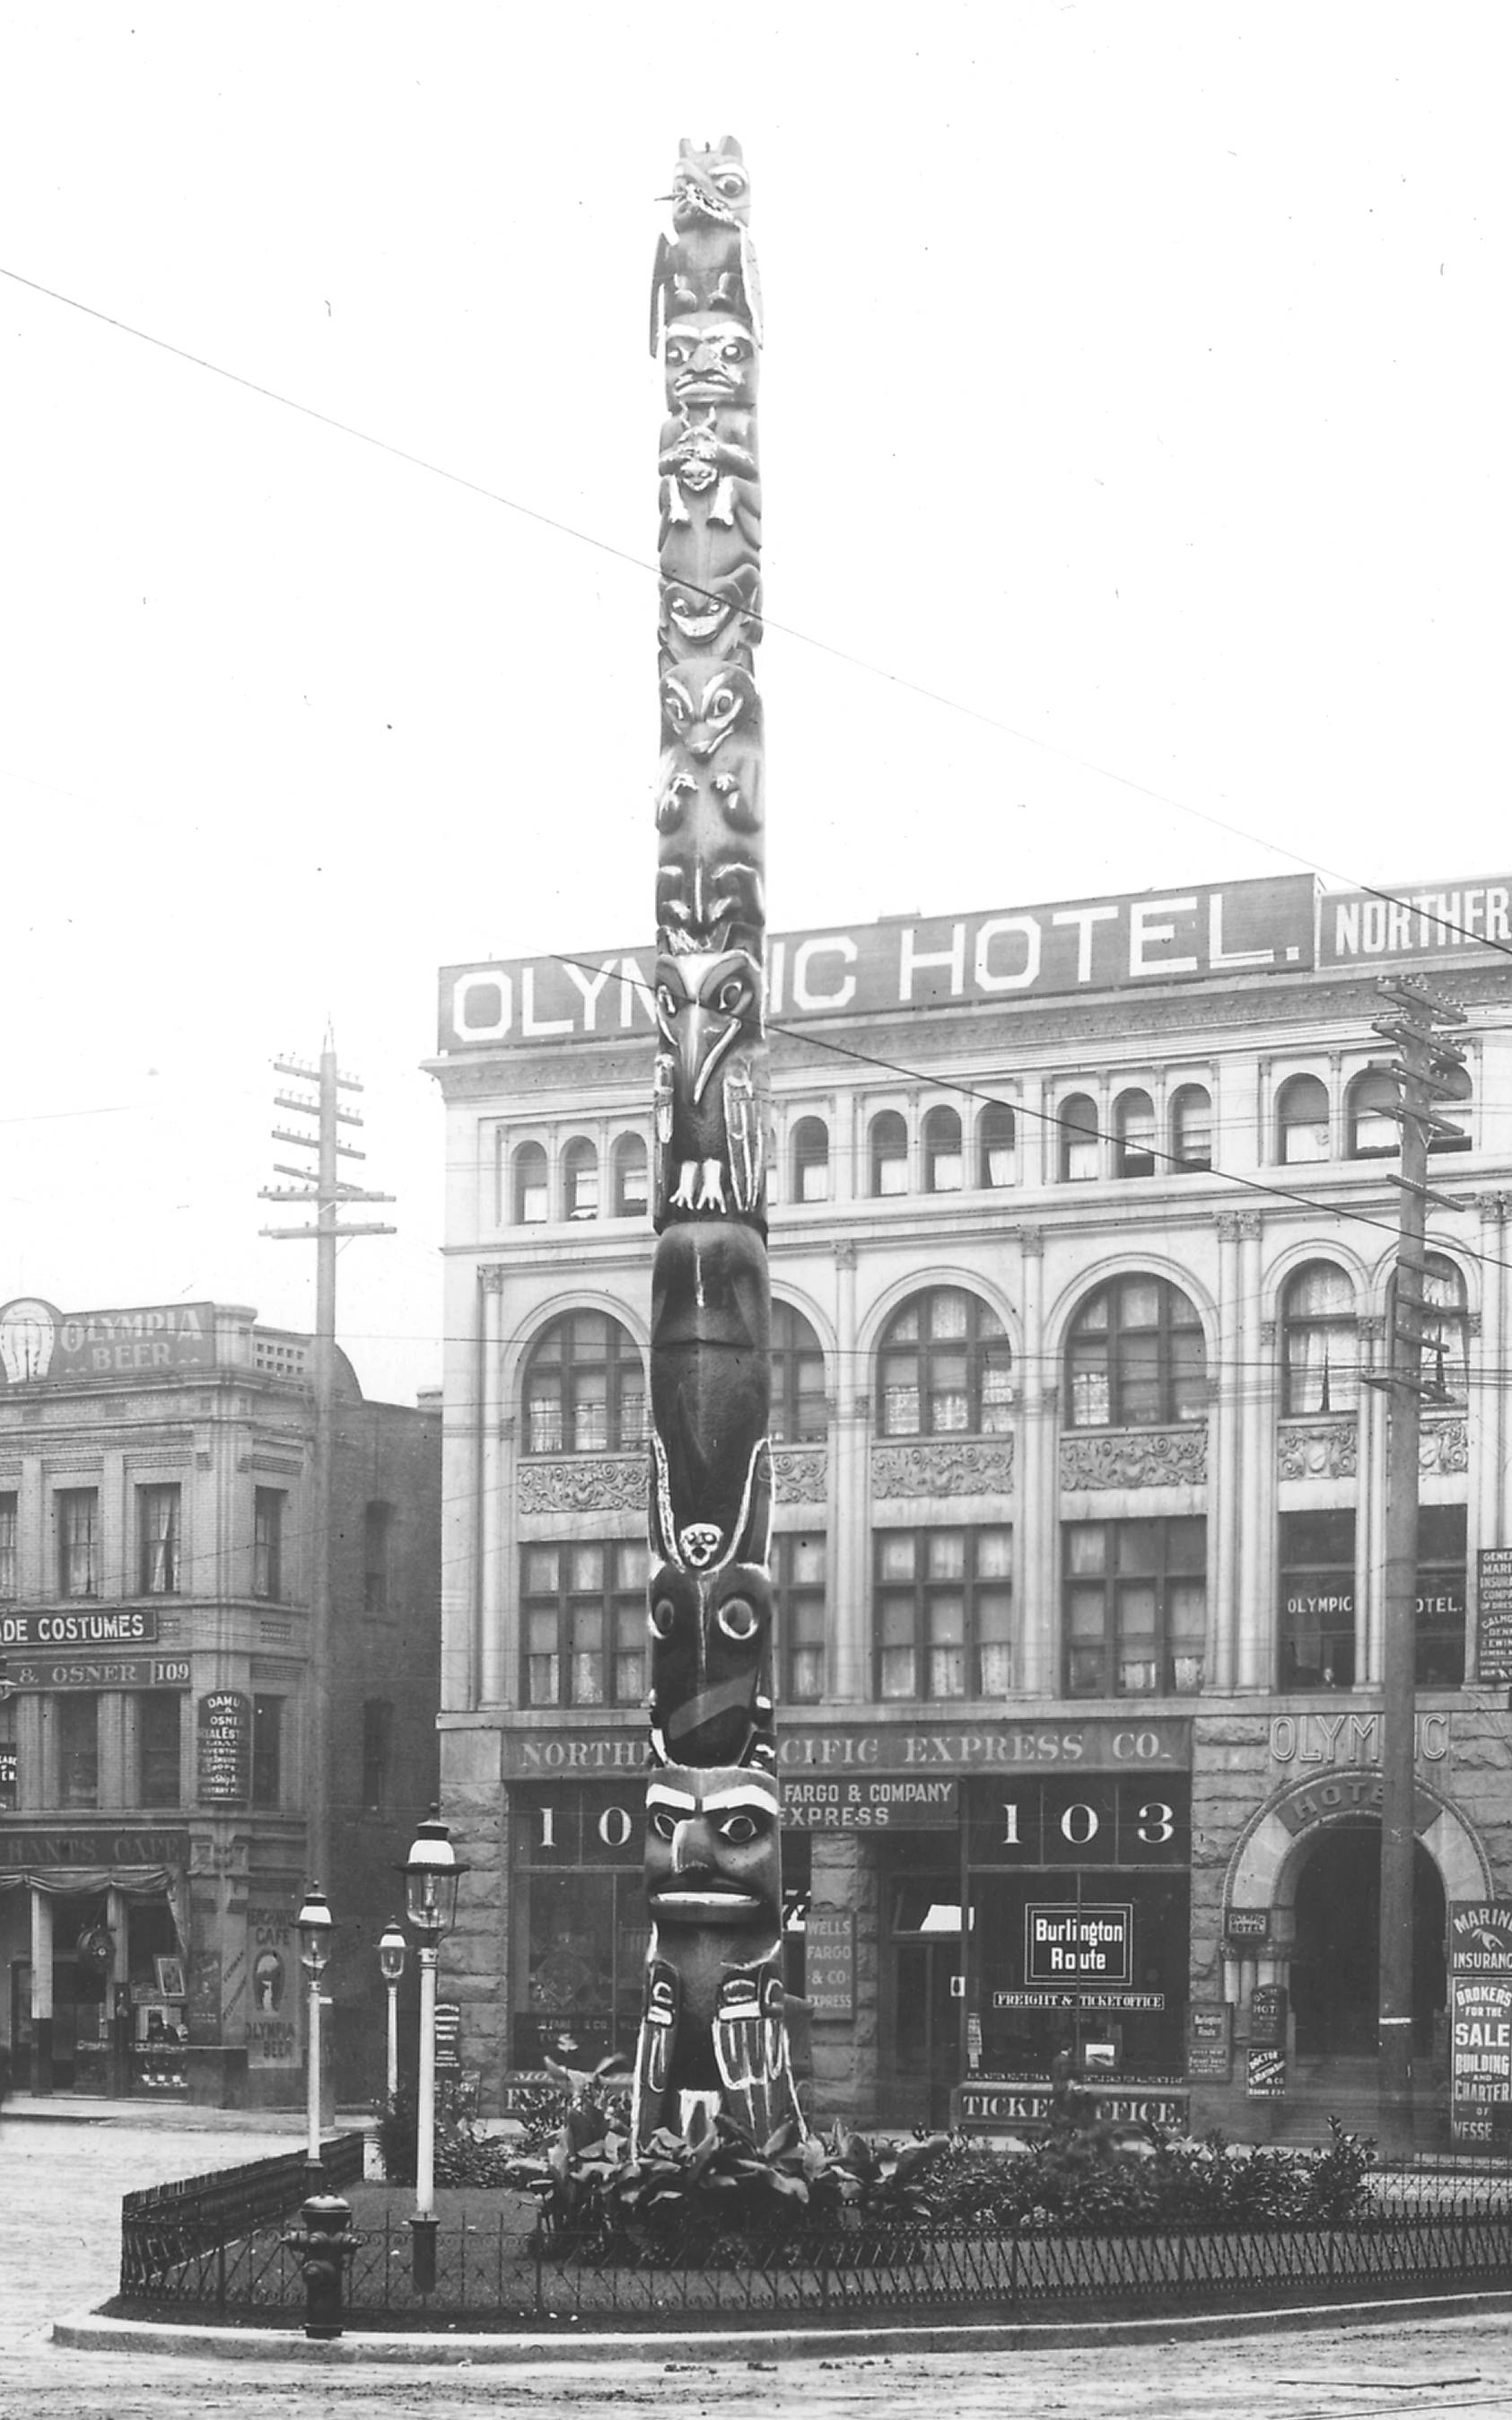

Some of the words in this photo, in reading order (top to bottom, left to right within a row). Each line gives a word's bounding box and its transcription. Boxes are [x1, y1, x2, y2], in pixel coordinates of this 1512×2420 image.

[453, 935, 858, 1042] OLYMIC
[898, 892, 1298, 1001] HOTEL.
[60, 1309, 204, 1353] OLYMPIA
[92, 1343, 171, 1371] BEER
[1288, 1596, 1353, 1613] OLYMPIC
[2, 1618, 28, 1642] DE
[38, 1614, 144, 1641] COSTUMES
[52, 1663, 137, 1684] OSNER
[157, 1662, 190, 1680] 109
[904, 1733, 1083, 1763] EXPRESS
[1113, 1732, 1172, 1758] CO.
[1270, 1713, 1446, 1761] OLYMIC
[785, 1784, 839, 1803] FARGO
[847, 1785, 862, 1802] &
[869, 1783, 952, 1802] COMPANY
[255, 1927, 291, 1946] CAFE
[808, 1921, 852, 1934] WELLS
[1036, 1919, 1123, 1946] Burlington
[807, 1946, 852, 1960] FARGO
[1051, 1947, 1106, 1970] Route
[811, 1970, 823, 1985] &
[998, 1995, 1057, 2005] FREIGHT
[1062, 1995, 1073, 2005] &
[1079, 1996, 1122, 2007] TICKET
[1123, 1996, 1162, 2008] OFFICE
[1455, 1986, 1512, 2007] BROKERS
[1464, 2006, 1481, 2018] FOR
[1485, 2006, 1505, 2018] THE
[245, 2022, 293, 2039] OLYMPIA
[1455, 2024, 1510, 2047] SALE
[263, 2041, 292, 2058] BEER
[1455, 2054, 1509, 2076] BUILDING
[1455, 2080, 1509, 2101] CHARTER
[1476, 2107, 1490, 2116] OF
[1454, 2121, 1493, 2141] VESSE
